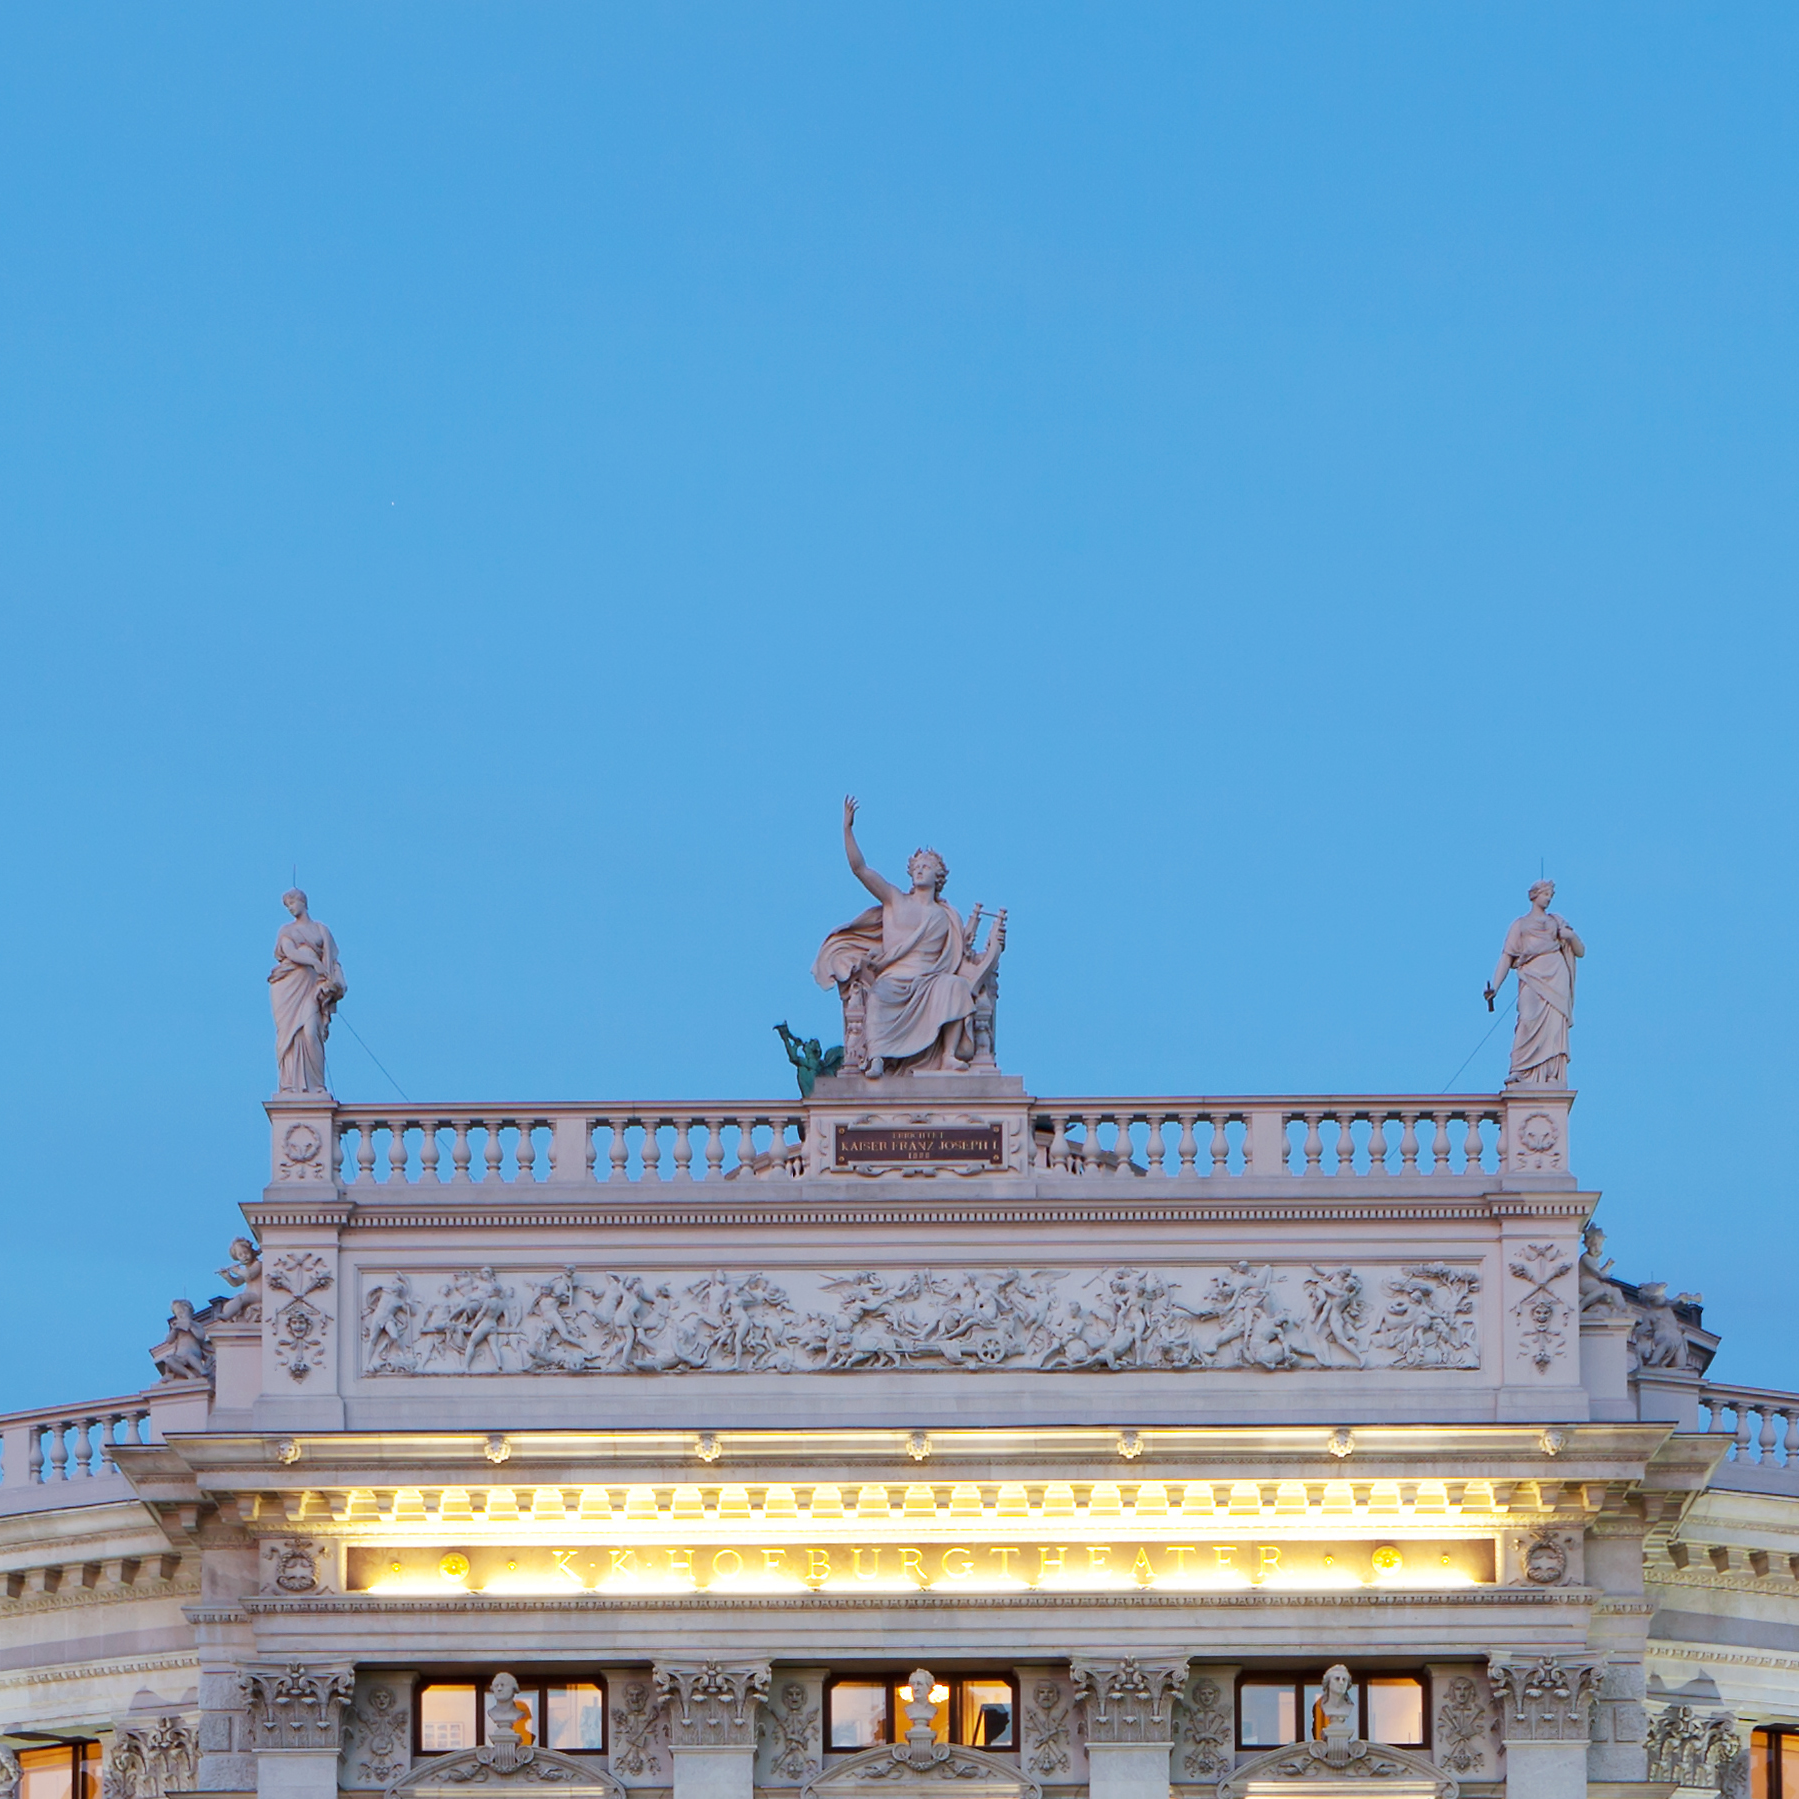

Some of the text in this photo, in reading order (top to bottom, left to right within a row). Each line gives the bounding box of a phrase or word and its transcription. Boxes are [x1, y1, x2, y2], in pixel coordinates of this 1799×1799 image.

[841, 1141, 888, 1151] KAISER
[891, 1141, 935, 1151] FRANZ
[938, 1140, 989, 1150] JOSEPH
